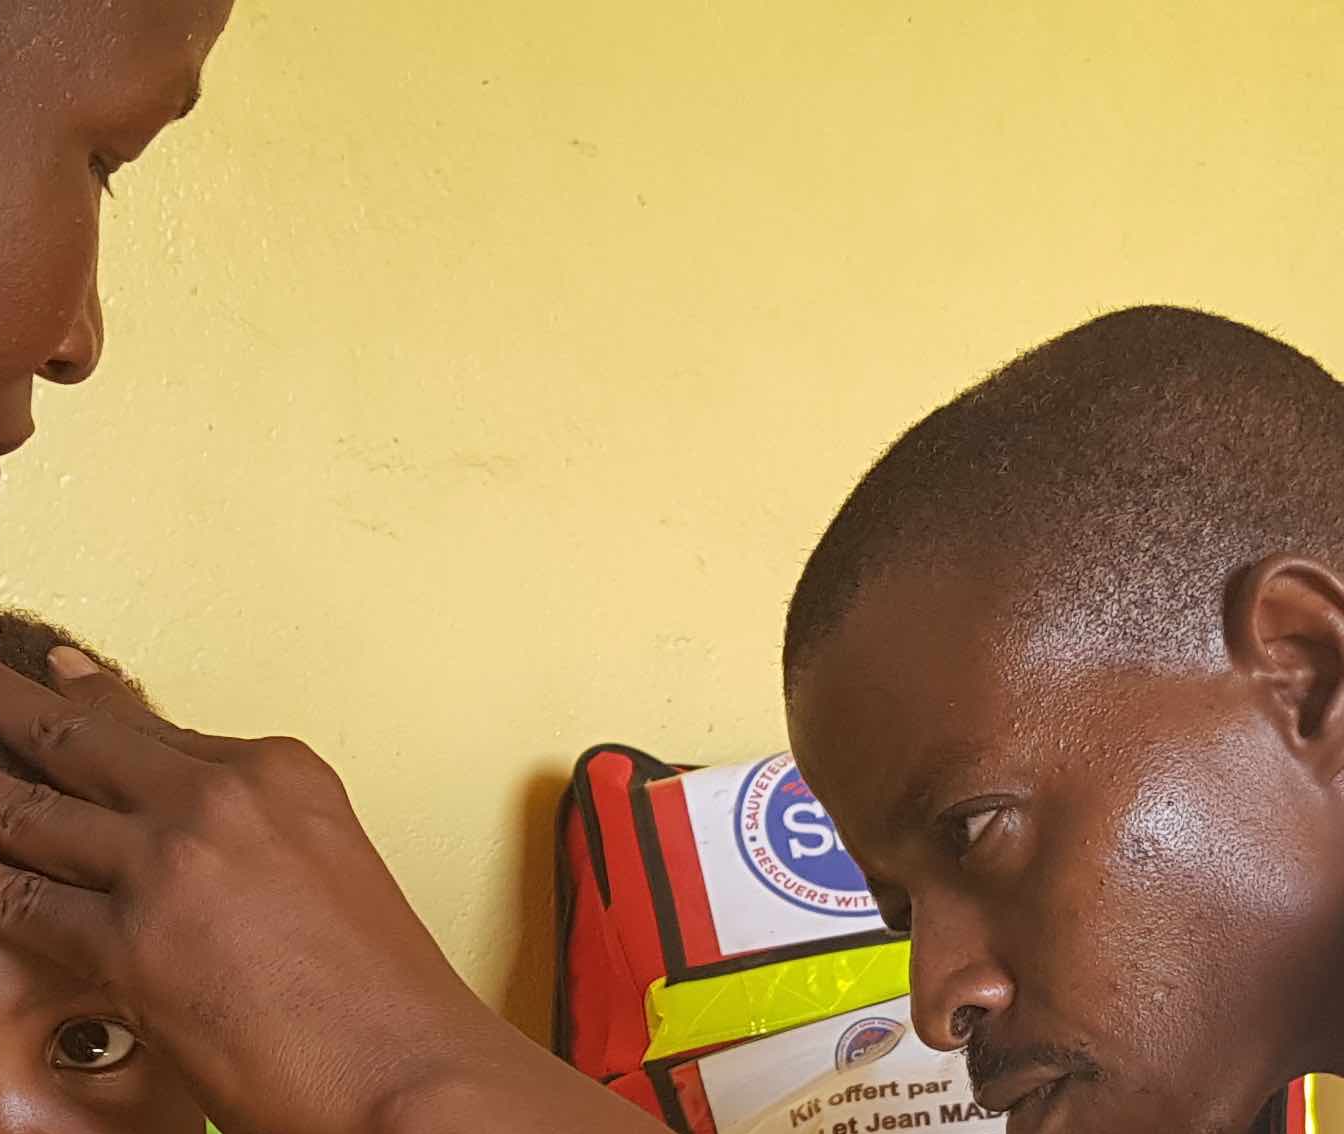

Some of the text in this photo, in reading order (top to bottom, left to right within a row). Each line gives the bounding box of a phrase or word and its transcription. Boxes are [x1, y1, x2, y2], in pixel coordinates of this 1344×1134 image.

[782, 800, 846, 860] S
[753, 846, 877, 908] RESCUERS WIT
[789, 1079, 953, 1129] Kit offert par
[866, 1111, 931, 1132] Jean
